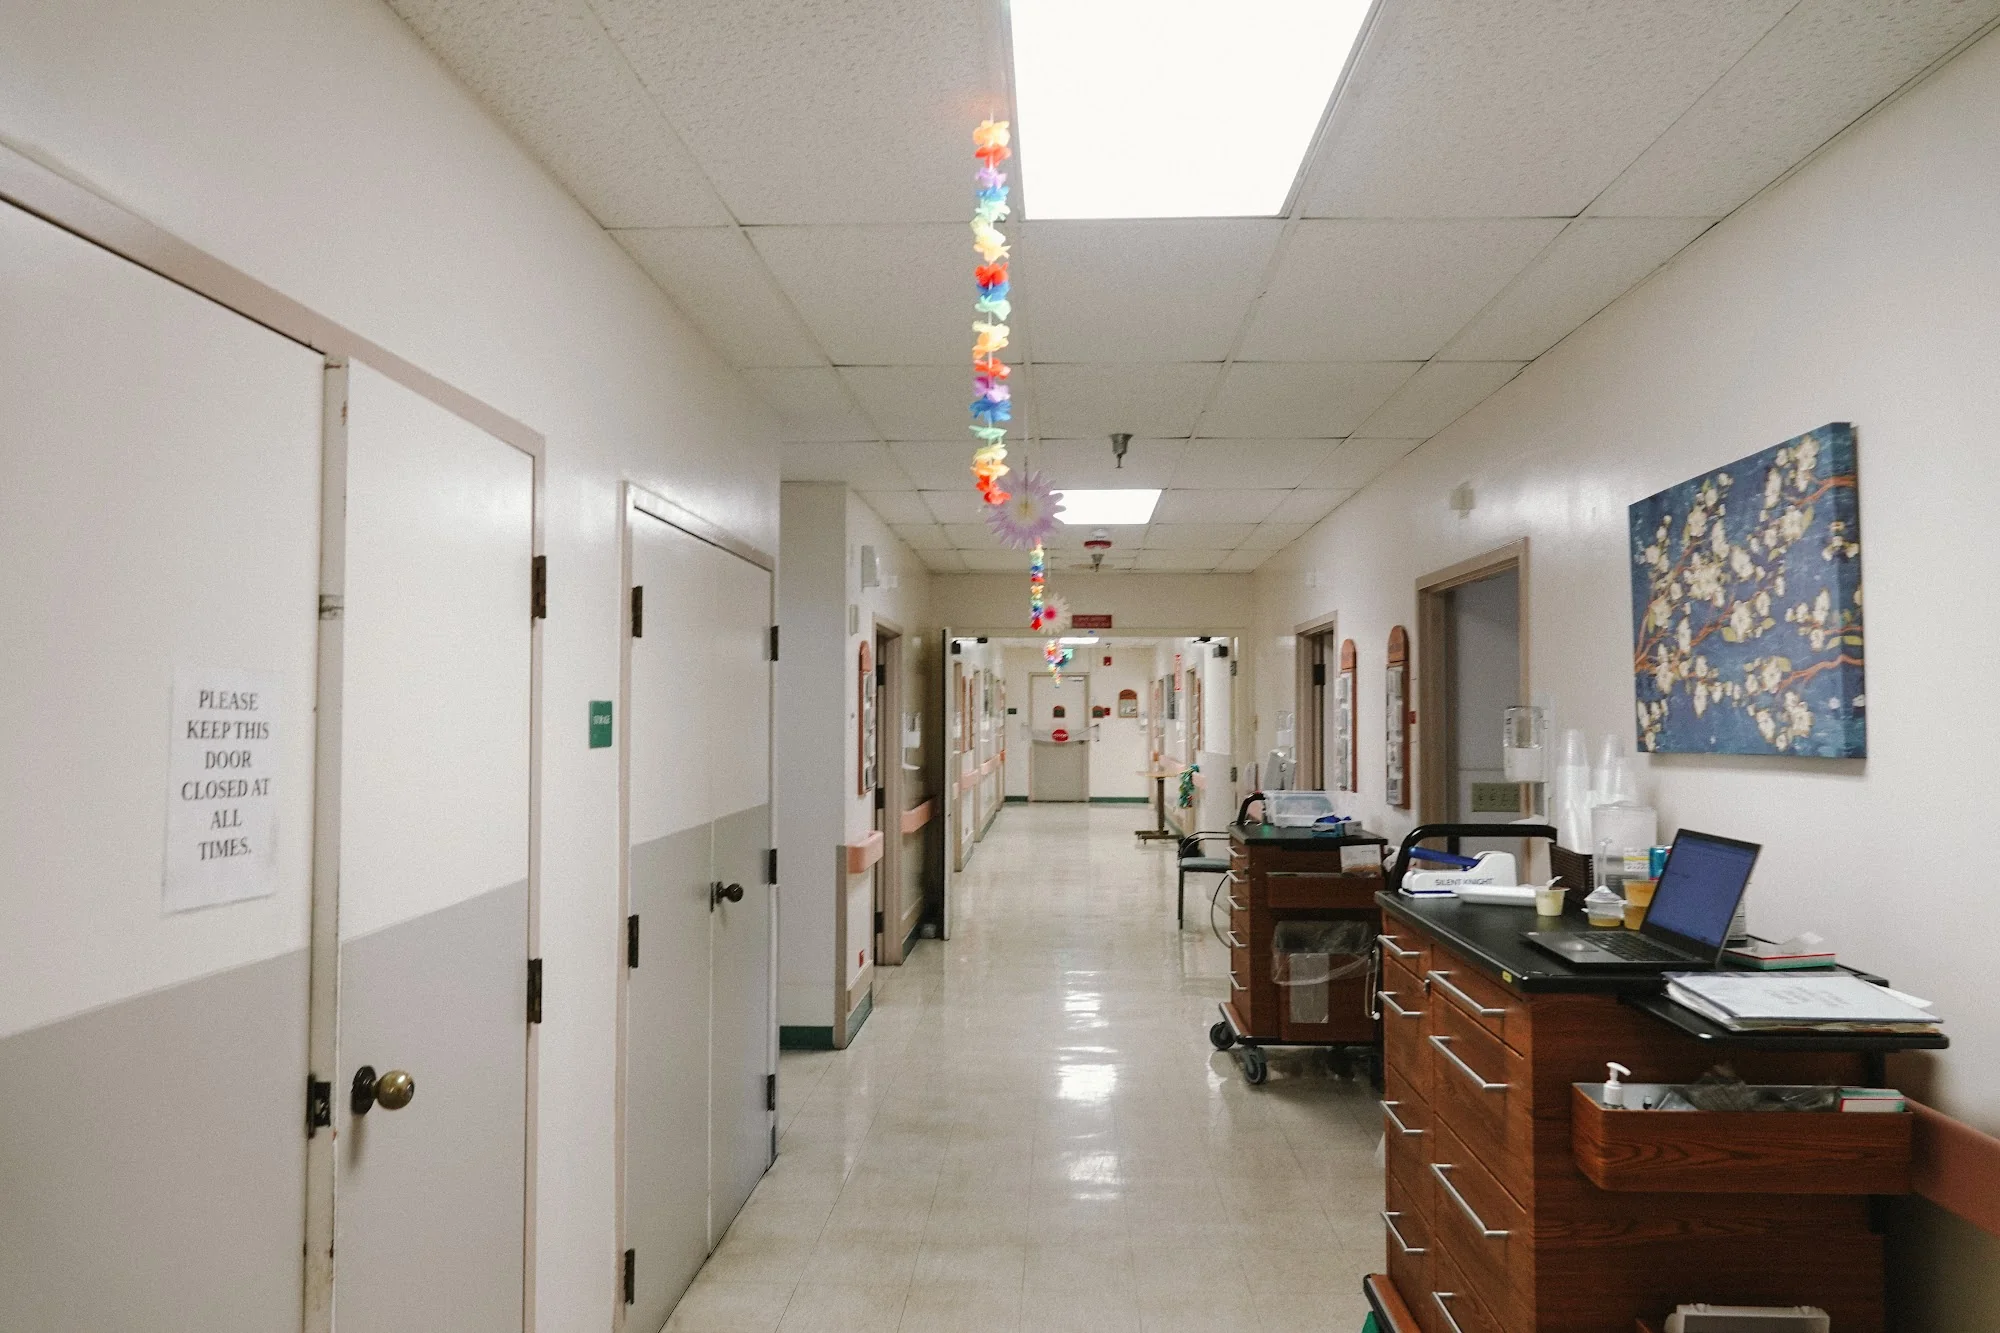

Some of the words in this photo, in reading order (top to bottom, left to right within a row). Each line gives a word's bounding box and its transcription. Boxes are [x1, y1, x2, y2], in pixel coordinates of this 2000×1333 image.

[199, 690, 259, 711] PLEASE
[187, 720, 231, 740] KEEP
[234, 721, 270, 740] THIS
[205, 750, 252, 770] DOOR
[181, 779, 248, 801] CLOSED
[251, 778, 270, 796] AT
[211, 809, 242, 831] ALL
[198, 837, 252, 861] TIMES.
[1435, 878, 1461, 886] SILENT
[1462, 877, 1494, 886] KNIGHT
